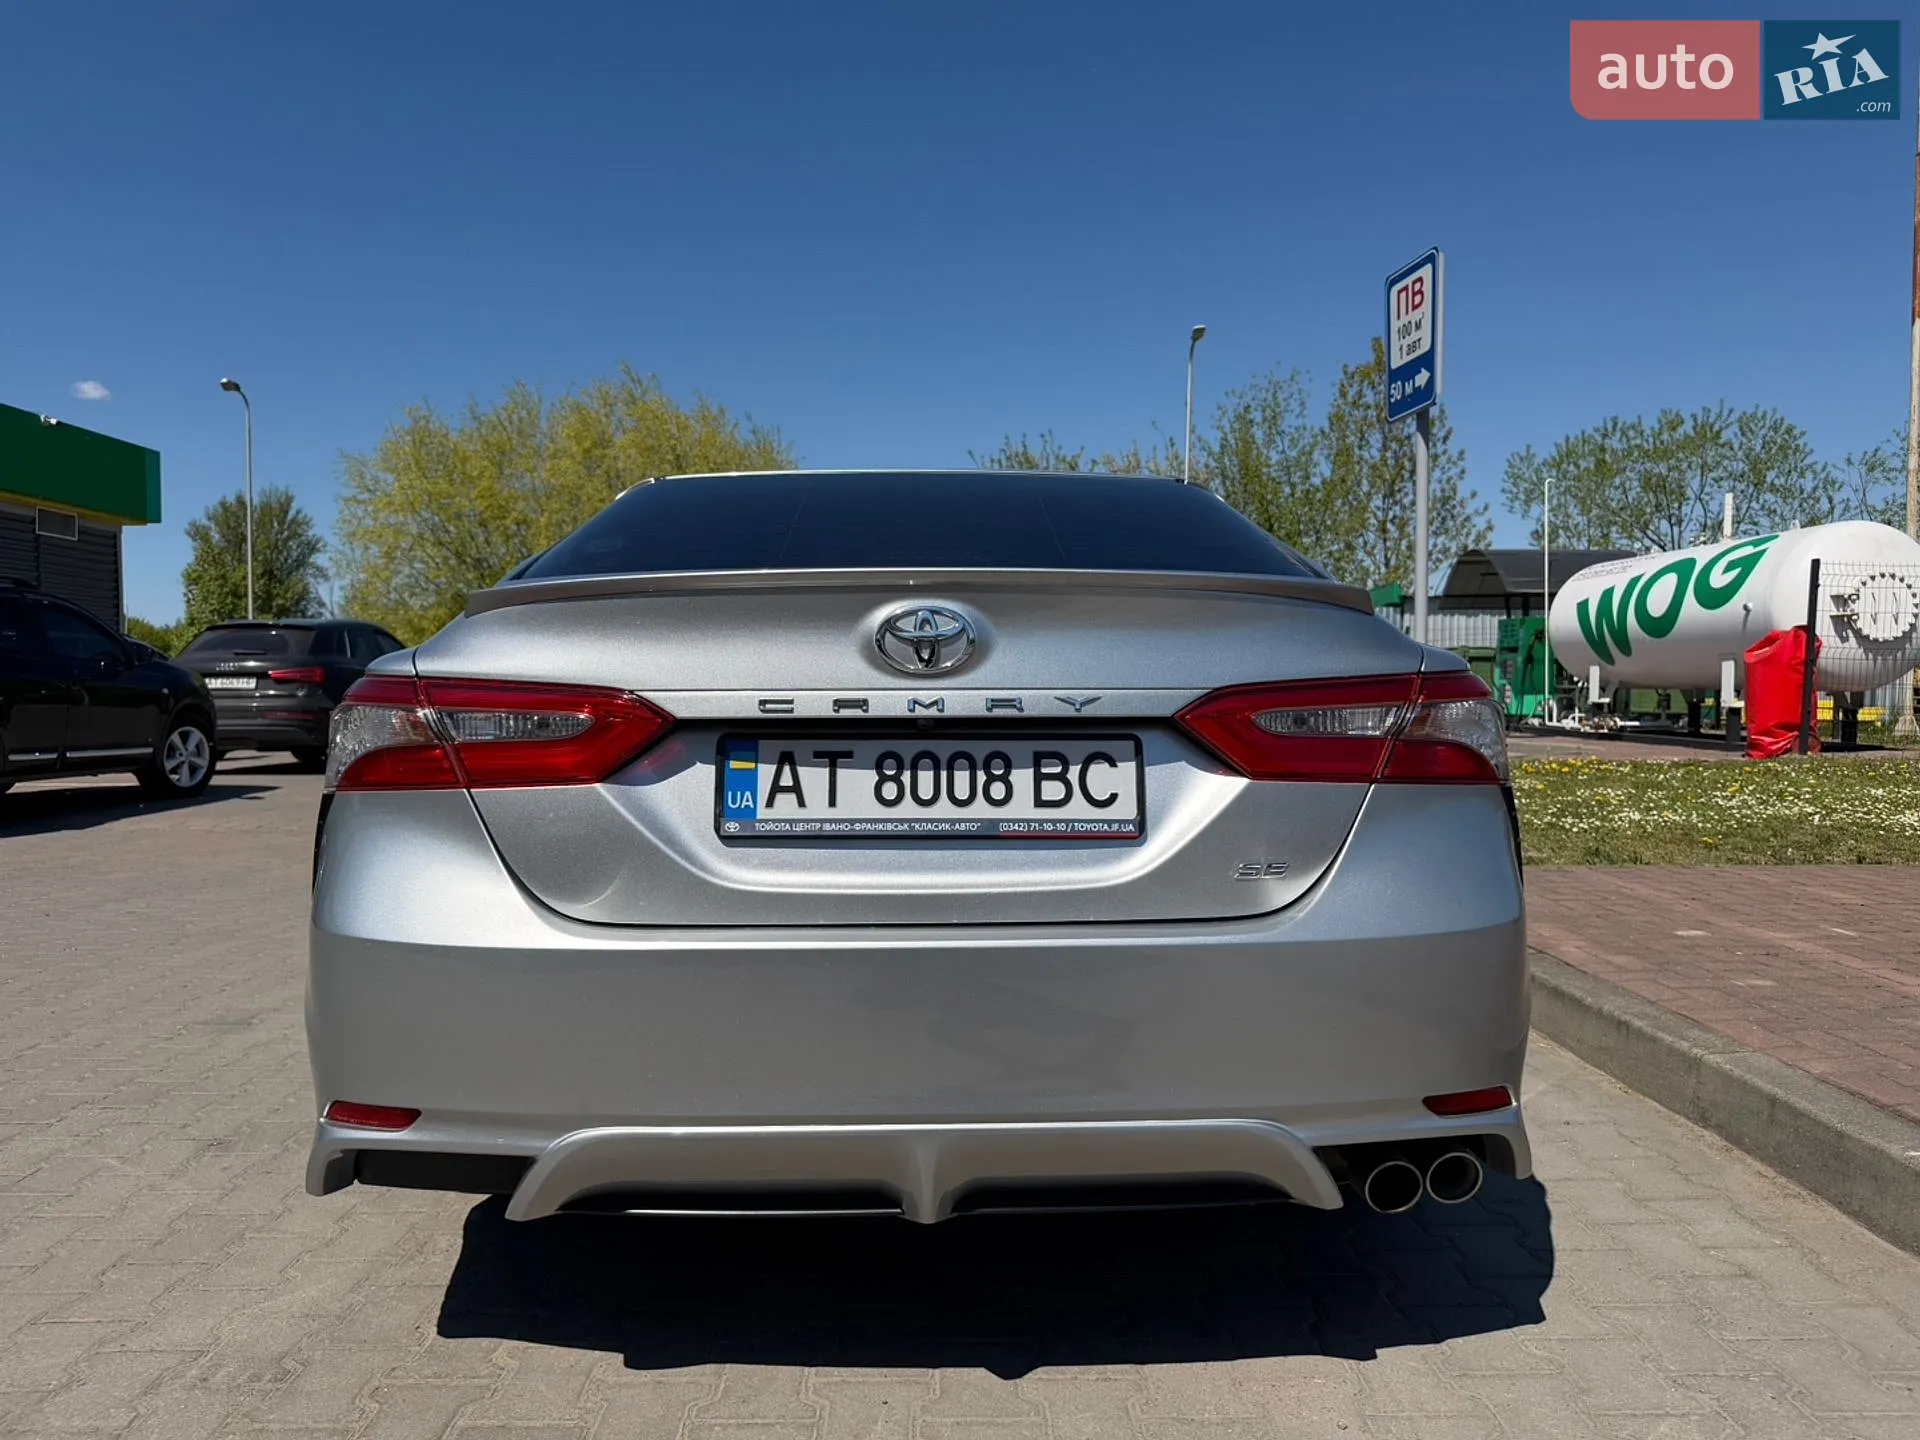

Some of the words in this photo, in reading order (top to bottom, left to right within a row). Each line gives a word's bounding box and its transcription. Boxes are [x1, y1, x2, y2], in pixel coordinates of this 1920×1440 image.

[1397, 276, 1425, 320] ПВ
[1397, 320, 1413, 342] 100
[1406, 337, 1423, 357] авт
[1390, 380, 1402, 403] 50
[1576, 534, 1780, 666] WOG
[758, 696, 1102, 713] CAMRY
[765, 750, 854, 809] AT
[873, 750, 1014, 808] 8008
[1033, 751, 1119, 809] BC
[727, 791, 754, 809] UA
[754, 821, 791, 831] ТОЙОТА
[792, 822, 820, 832] ЦЕНТР
[1000, 822, 1028, 832] (0342)
[1030, 822, 1066, 831] 71-10-10
[1233, 862, 1289, 879] SE
